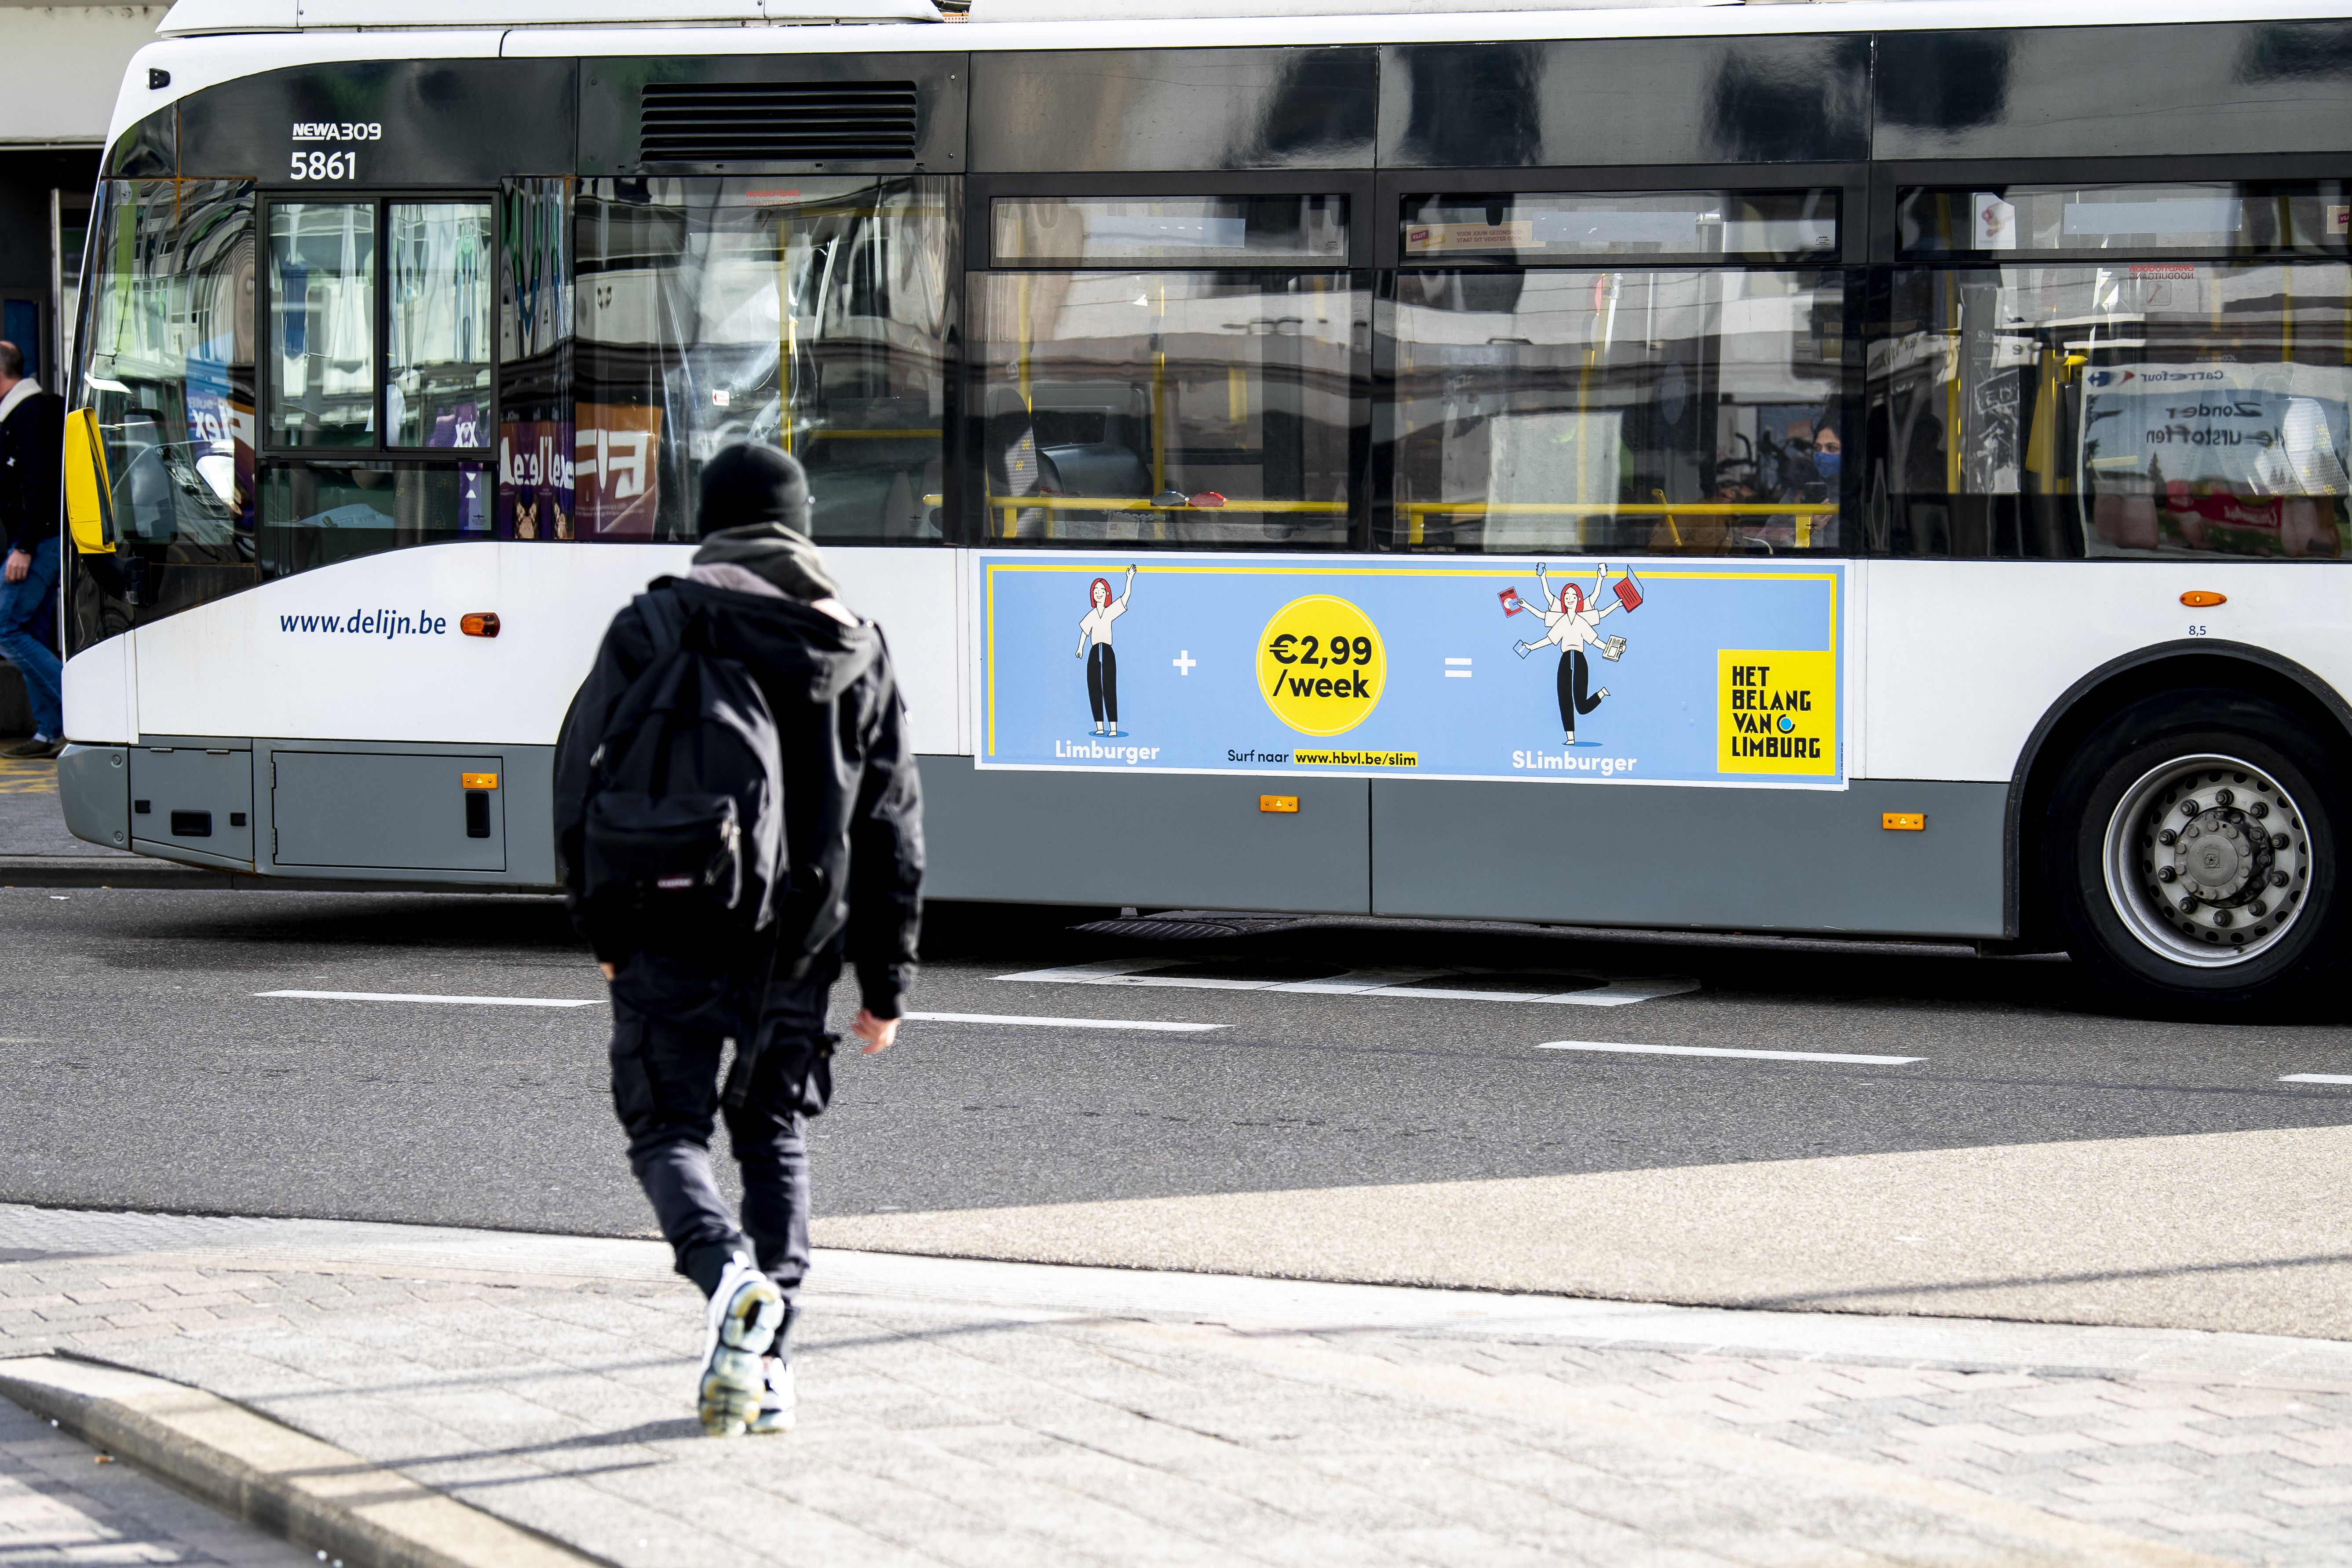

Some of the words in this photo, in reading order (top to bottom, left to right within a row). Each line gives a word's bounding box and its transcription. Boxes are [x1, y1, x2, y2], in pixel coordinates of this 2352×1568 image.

[290, 151, 355, 180] 5861
[2129, 263, 2195, 272] NOODUITGANG
[280, 608, 446, 640] www.delijn.be
[2188, 625, 2206, 637] 8,5
[1269, 634, 1372, 670] €2,99
[1272, 669, 1370, 698] /week
[1732, 665, 1770, 687] HET
[1732, 689, 1811, 711] BELANG
[1732, 713, 1771, 735] VAN
[1055, 740, 1160, 765] Limburger
[1227, 749, 1255, 762] Surf
[1257, 752, 1289, 763] naar
[1295, 752, 1416, 766] www.hbvl.be/slim
[1732, 736, 1820, 759] LIMBURG
[1512, 750, 1637, 776] SLimburger
